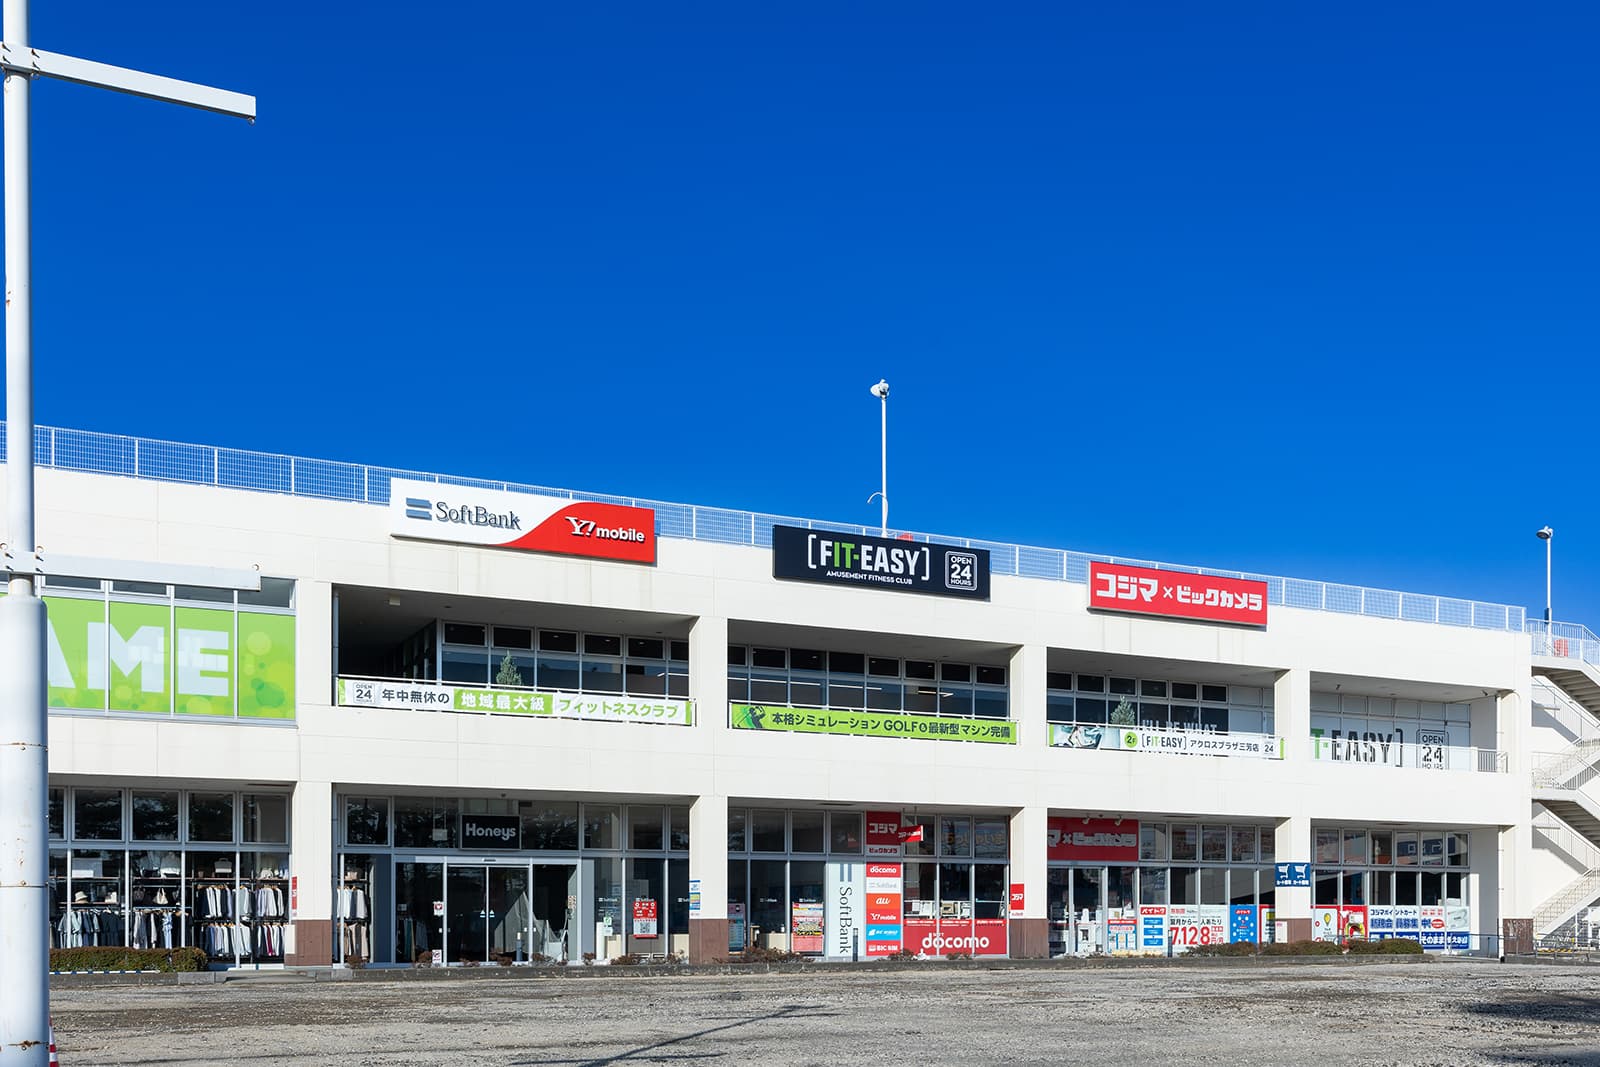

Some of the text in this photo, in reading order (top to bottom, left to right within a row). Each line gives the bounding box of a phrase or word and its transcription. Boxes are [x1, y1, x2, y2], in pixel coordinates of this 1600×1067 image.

[435, 501, 645, 542] SoftBank Y!mobile
[951, 556, 972, 564] OPEN
[826, 570, 913, 585] AMUSEMENT FITNESS CLUB
[951, 564, 972, 580] 24
[1096, 573, 1158, 602] コジマ
[1176, 585, 1263, 611] ビックカメラ
[355, 689, 373, 699] 24
[381, 688, 679, 718] 年中無休の 地域最大級 フィットネスクラブ
[1422, 735, 1444, 744] OPEN
[1264, 744, 1274, 752] 24
[465, 823, 517, 841] Honeys
[869, 823, 898, 834] コジマ
[875, 897, 891, 905] au
[839, 887, 853, 954] SoftBank
[922, 933, 990, 949] docomo
